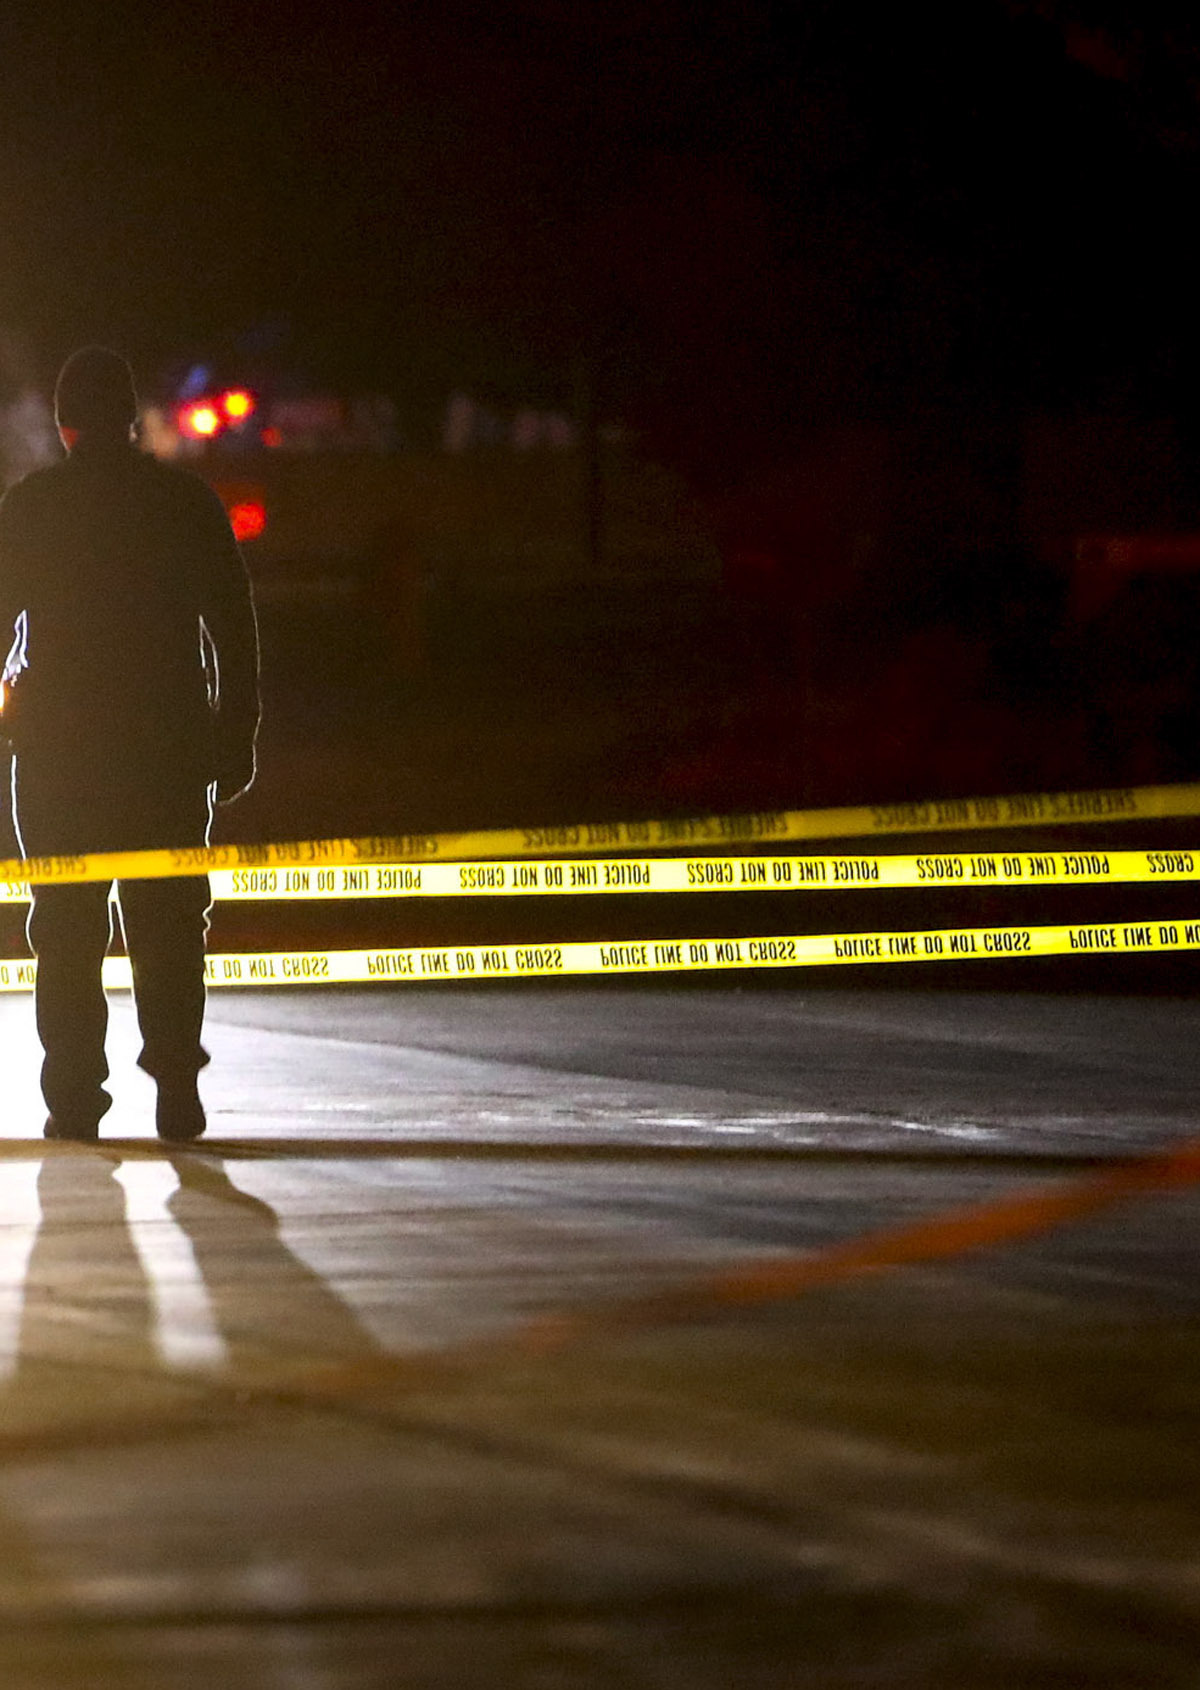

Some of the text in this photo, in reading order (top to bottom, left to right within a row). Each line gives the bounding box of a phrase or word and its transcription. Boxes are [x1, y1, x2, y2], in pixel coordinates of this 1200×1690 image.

[523, 826, 579, 848] CROSS
[587, 823, 619, 844] NOT
[169, 847, 229, 869] CROSS
[237, 845, 270, 867] NOT
[308, 840, 345, 862] LINE
[687, 860, 879, 884] POLICE LINE DO NOT CROSS
[916, 854, 1110, 879] POLICE LINE DO NOT CROSS
[1147, 853, 1194, 874] CROSS
[232, 869, 422, 892] POLICE LINE DO NOT CROSS
[459, 864, 650, 888] POLICE LINE DO NOT CROSS
